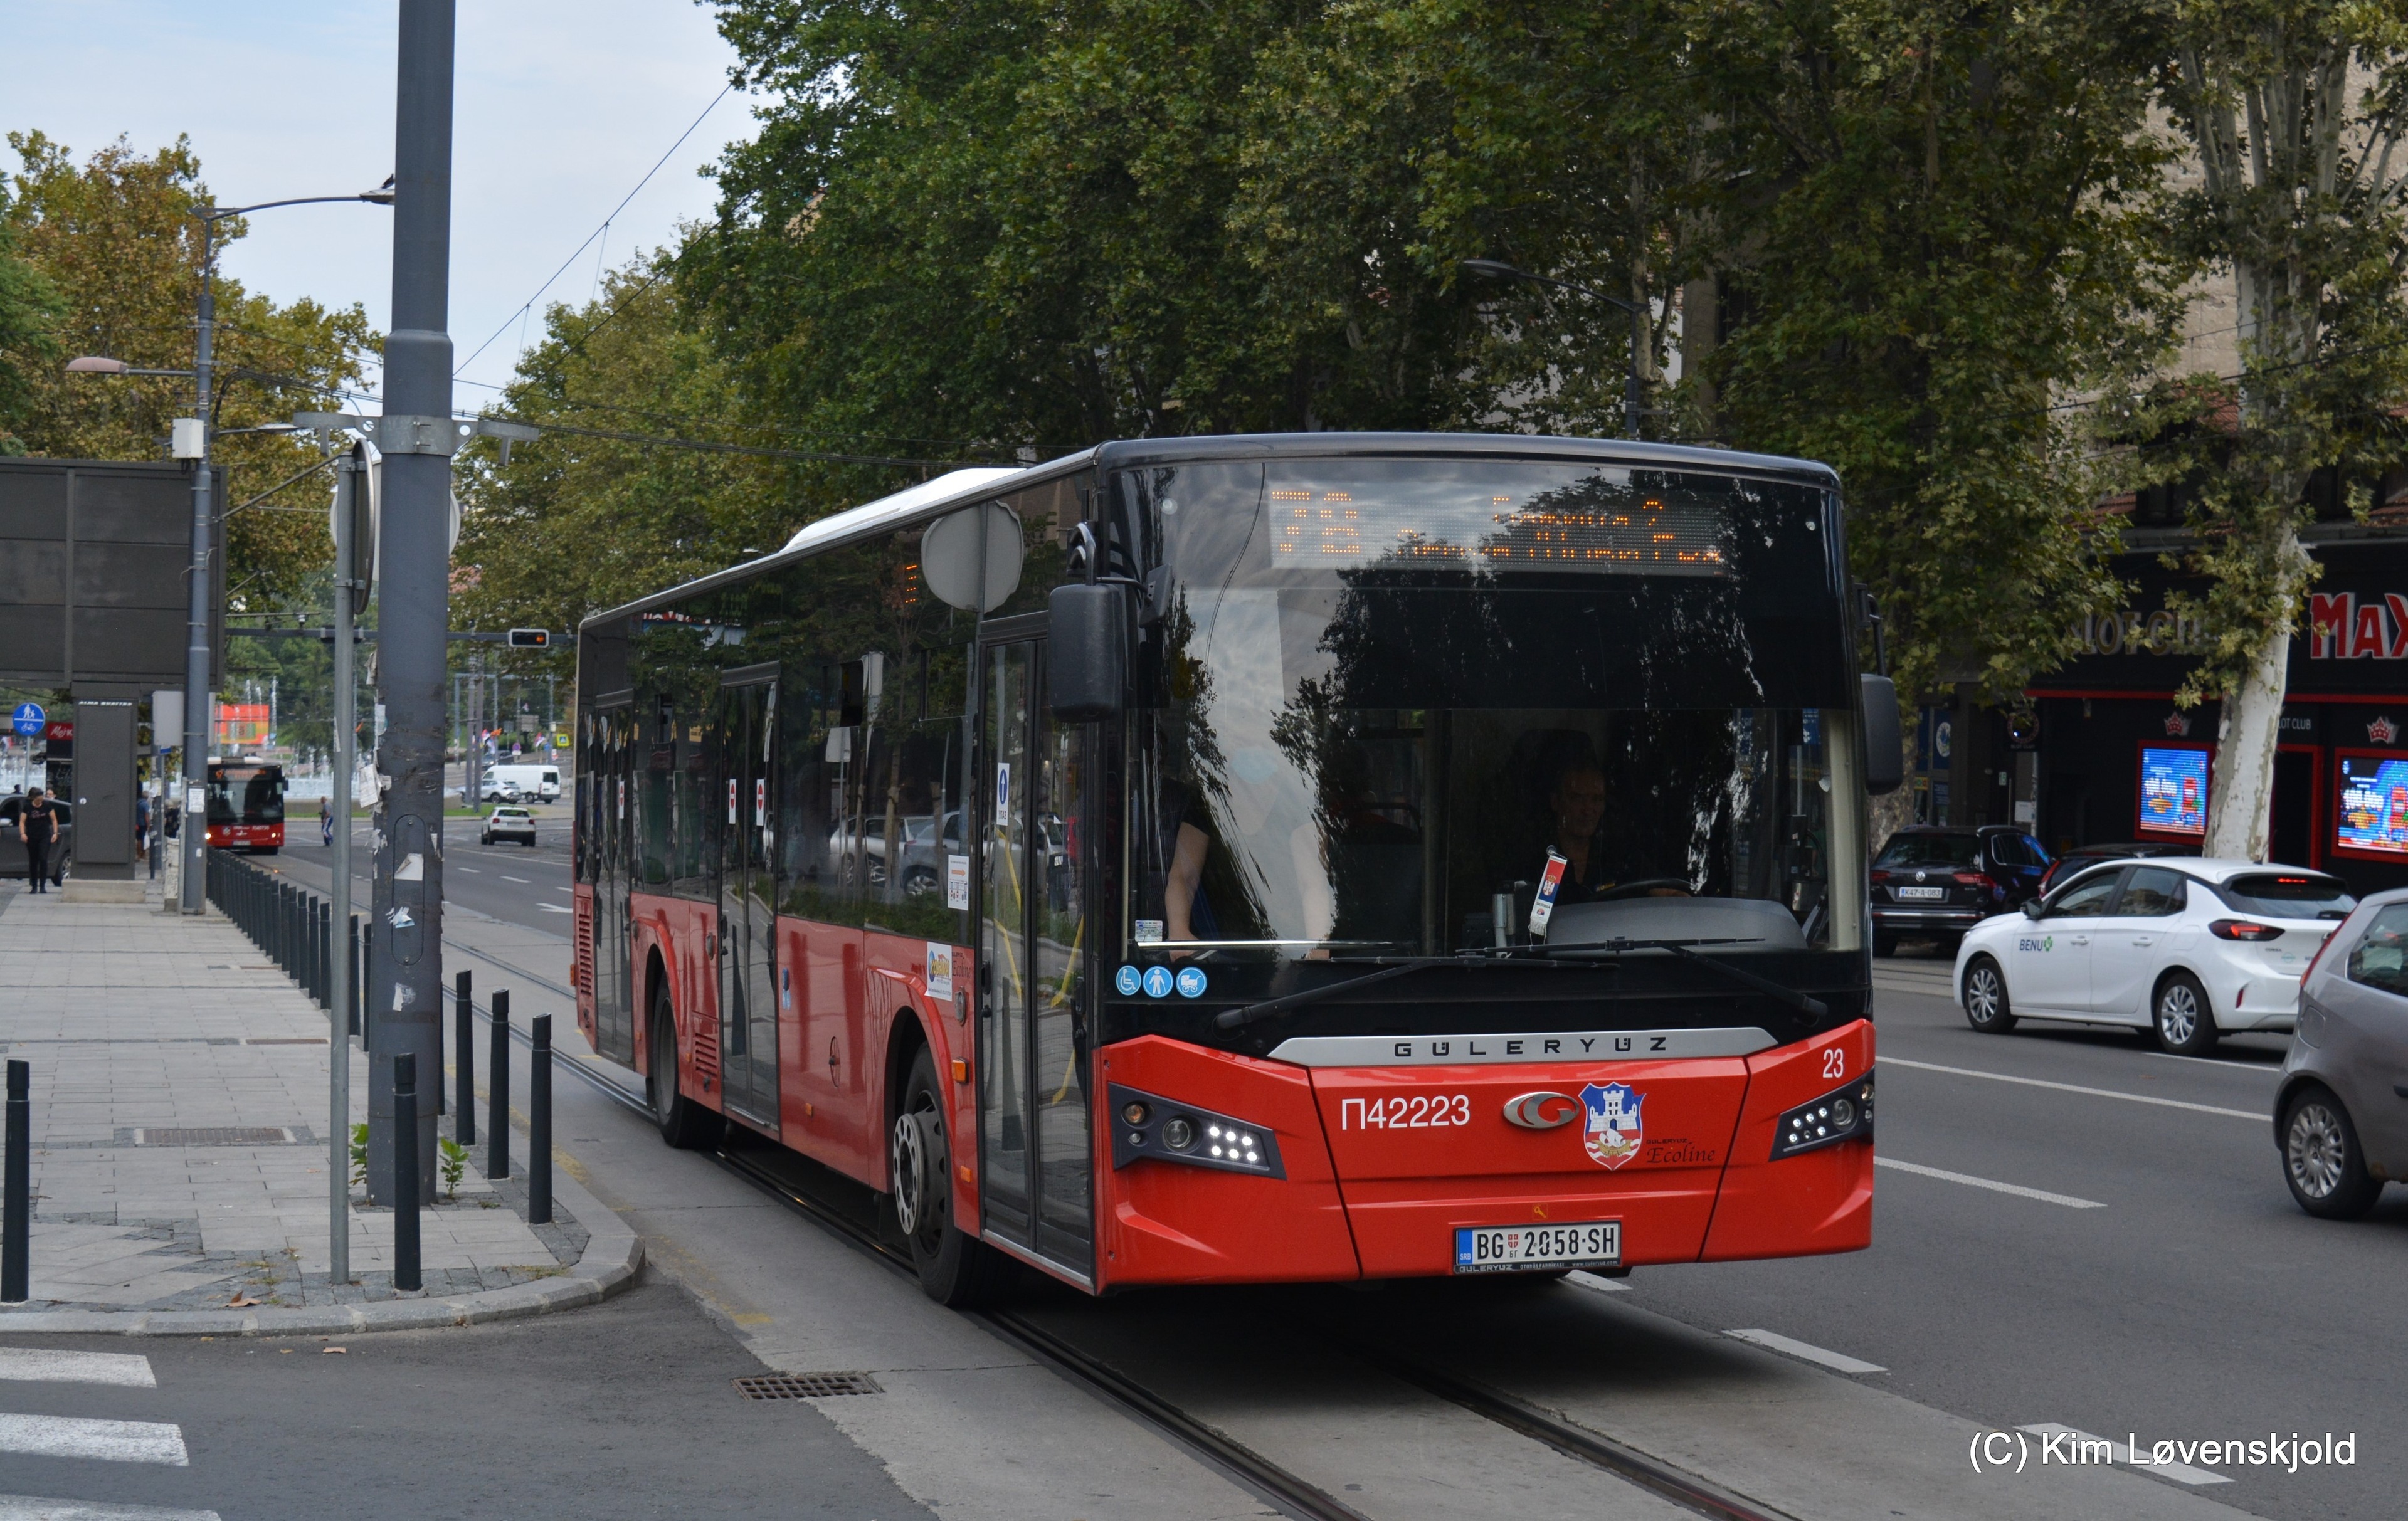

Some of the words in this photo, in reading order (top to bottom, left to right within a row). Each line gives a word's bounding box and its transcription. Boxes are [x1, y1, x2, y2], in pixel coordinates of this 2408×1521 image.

[2291, 718, 2311, 730] CLUB
[2019, 939, 2043, 952] BENU
[1822, 1048, 1844, 1078] 23
[1341, 1095, 1471, 1130] П42223
[1646, 1142, 1716, 1164] Ecoline
[1460, 1253, 1471, 1261] SRB
[1477, 1233, 1504, 1260] BG
